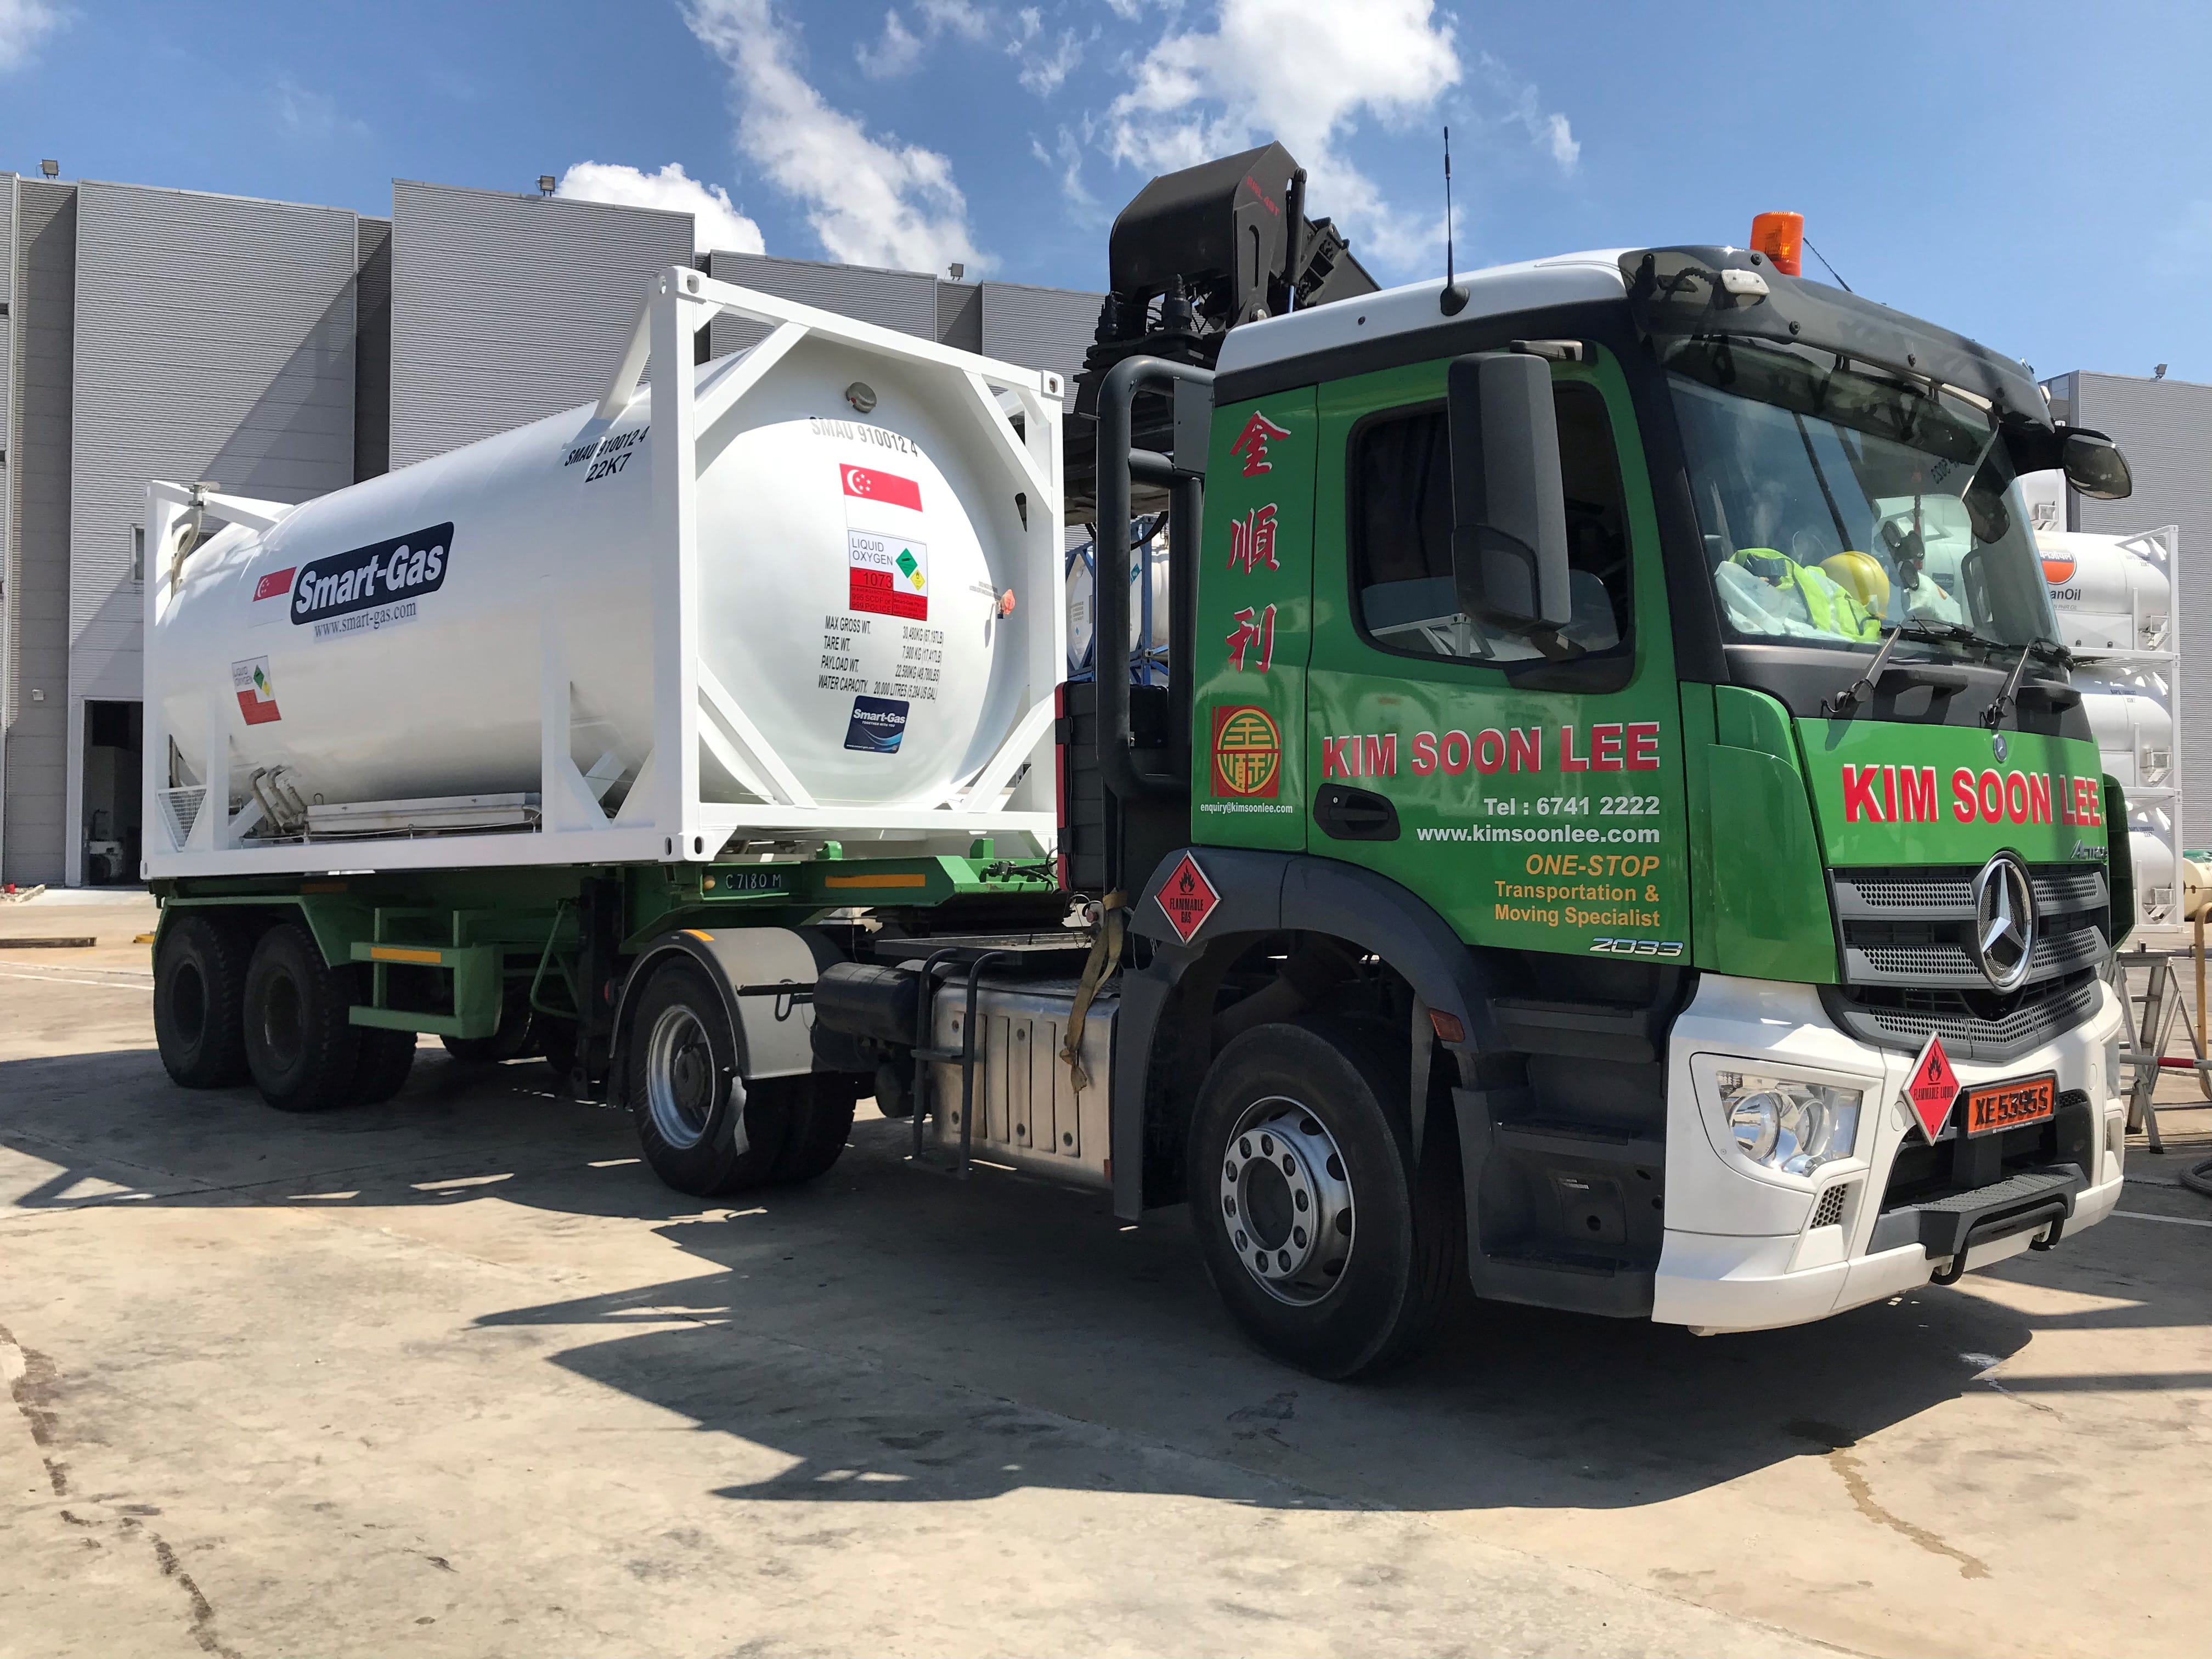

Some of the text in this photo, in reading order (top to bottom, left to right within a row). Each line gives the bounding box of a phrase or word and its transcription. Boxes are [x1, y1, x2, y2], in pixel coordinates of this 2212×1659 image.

[564, 426, 650, 466] SMAU 910012 4
[809, 416, 918, 457] SMAU 910012 4
[585, 452, 632, 483] 22K7
[851, 538, 884, 552] LIQUID
[1225, 410, 1291, 674] 金順利
[852, 550, 893, 566] OXYGEN
[295, 544, 443, 614] Smart-Gas
[864, 572, 893, 589] 1073
[865, 595, 883, 603] SCDF
[2050, 588, 2081, 601] anOil
[865, 603, 891, 613] POLICE
[314, 602, 416, 637] www.smart-gas.com
[825, 615, 871, 634] MAX GROSS WT.
[824, 635, 850, 652] TARE WT.
[821, 654, 859, 673] PAYLOAD WT.
[914, 647, 922, 661] KG
[818, 674, 839, 690] WATER
[840, 677, 868, 693] CAPACITY.
[873, 681, 890, 697] 20,000
[890, 682, 907, 697] LITRES
[920, 686, 927, 699] US
[853, 708, 906, 724] Smart-Gas
[1323, 721, 1660, 778] KIM SOON LEE
[1842, 763, 2102, 827] KIM SOON LEE
[1200, 802, 1293, 815] enquiry@kimsoonlee.com
[1483, 798, 1516, 816] Tel
[1537, 797, 1590, 816] 6741
[1600, 795, 1660, 816] 2222
[1417, 824, 1660, 843] www.kimsoonlee.com
[1526, 854, 1660, 877] ONE-STOP
[725, 873, 782, 889] C 7180 M
[1494, 881, 1660, 902] Transportation &
[1169, 898, 1204, 911] FLAMMABLE
[1181, 911, 1192, 923] GAS
[1495, 904, 1660, 928] Moving Specialist
[1589, 937, 1684, 956] 2033
[1914, 1086, 1954, 1101] FLAMMABLE LIQUID
[1975, 1086, 2049, 1126] XE5395S
